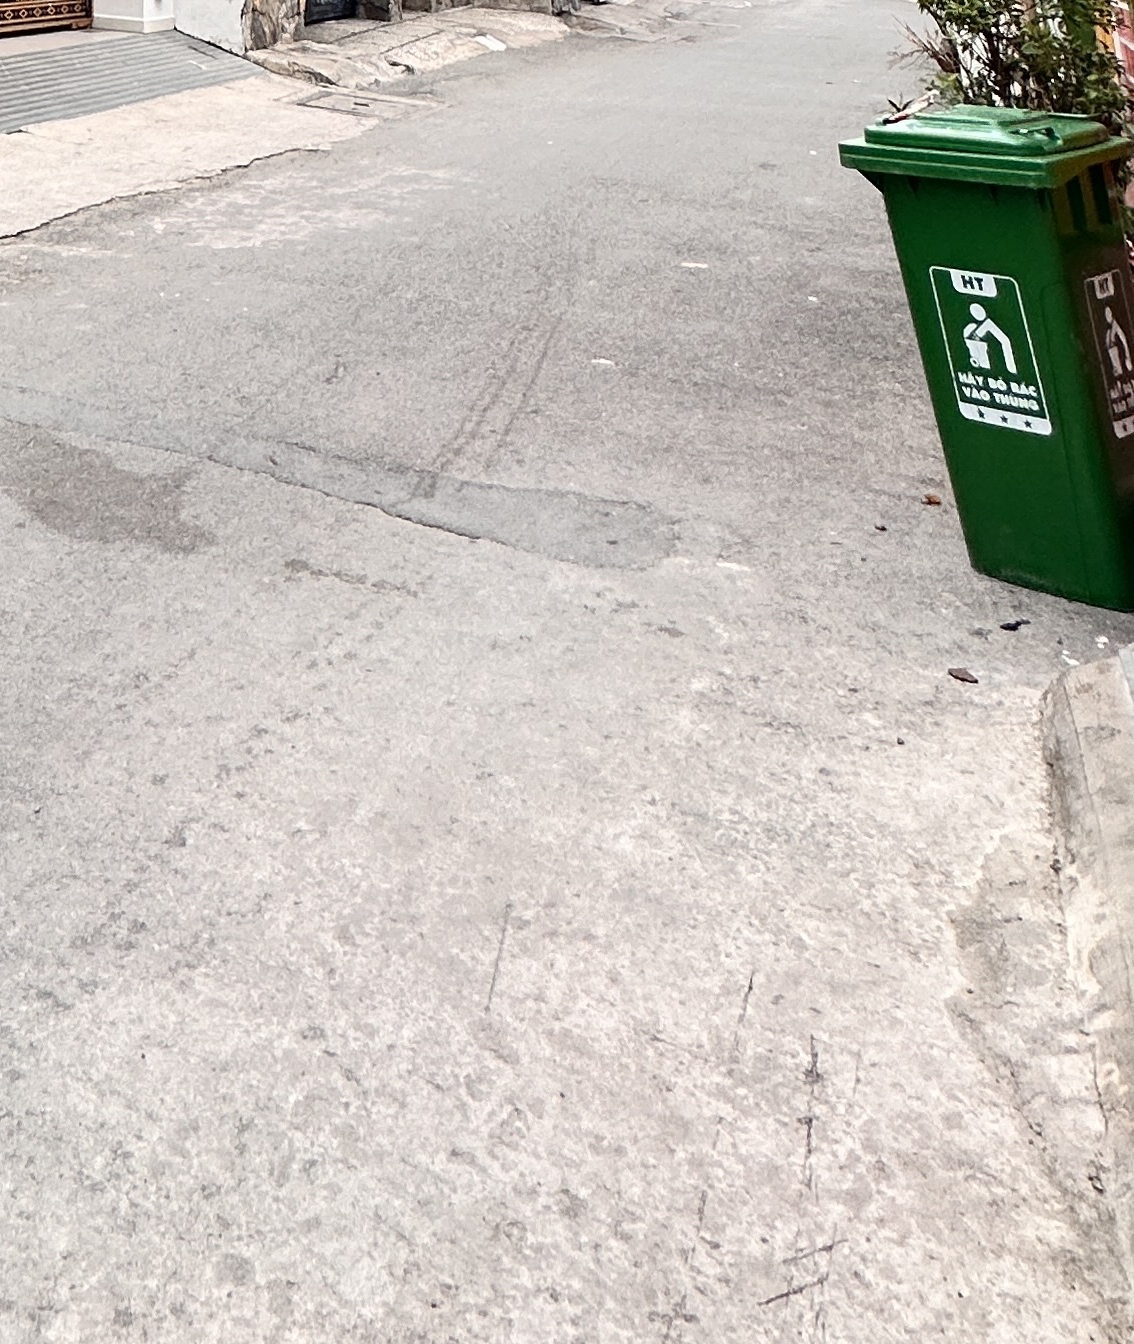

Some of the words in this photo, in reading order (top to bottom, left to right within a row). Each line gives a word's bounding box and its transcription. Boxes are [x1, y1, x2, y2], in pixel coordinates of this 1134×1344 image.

[961, 275, 984, 291] HT
[962, 385, 991, 402] VÀO
[993, 393, 1040, 411] THÙNG
